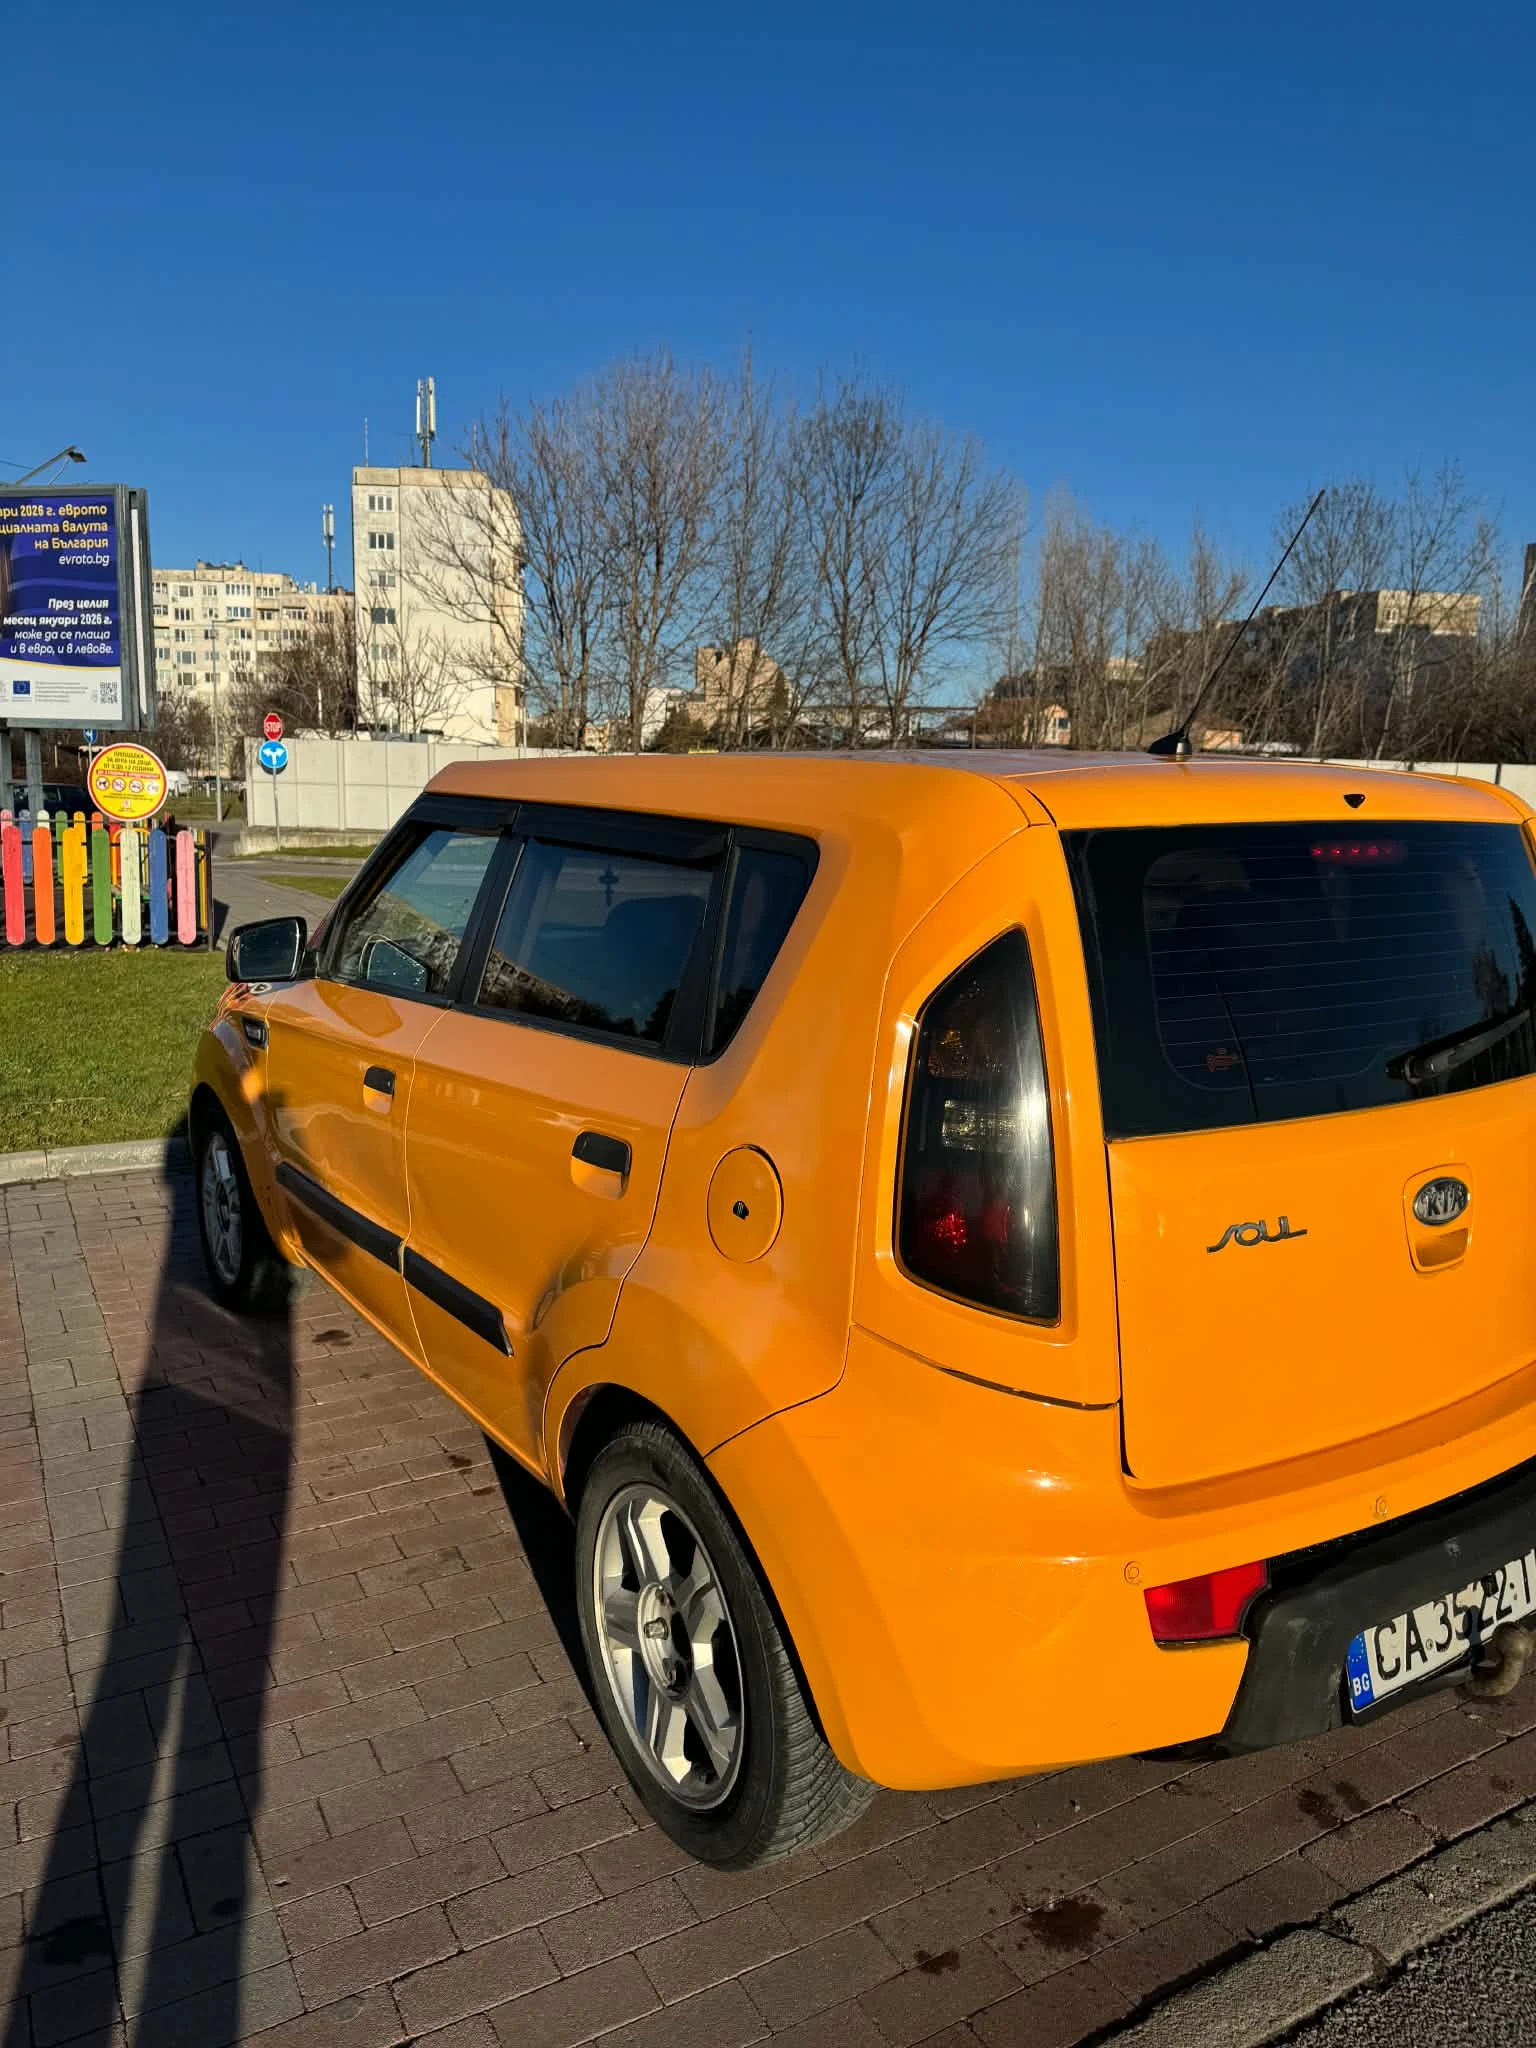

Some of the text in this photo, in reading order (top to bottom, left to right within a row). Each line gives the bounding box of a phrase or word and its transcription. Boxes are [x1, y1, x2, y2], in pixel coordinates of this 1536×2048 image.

[20, 505, 44, 517] 2026
[46, 507, 56, 516] г.
[58, 504, 107, 518] еврото
[62, 520, 108, 534] валута
[34, 537, 109, 551] на България
[58, 552, 110, 567] evroto.bg
[48, 598, 109, 611] През целия
[3, 616, 37, 627] месец
[39, 616, 78, 627] януари
[80, 613, 102, 625] 2026
[15, 628, 111, 642] може да се плаща
[10, 642, 114, 657] и в евро, и в левове.
[264, 721, 282, 734] STOP
[1352, 1673, 1370, 1697] BG
